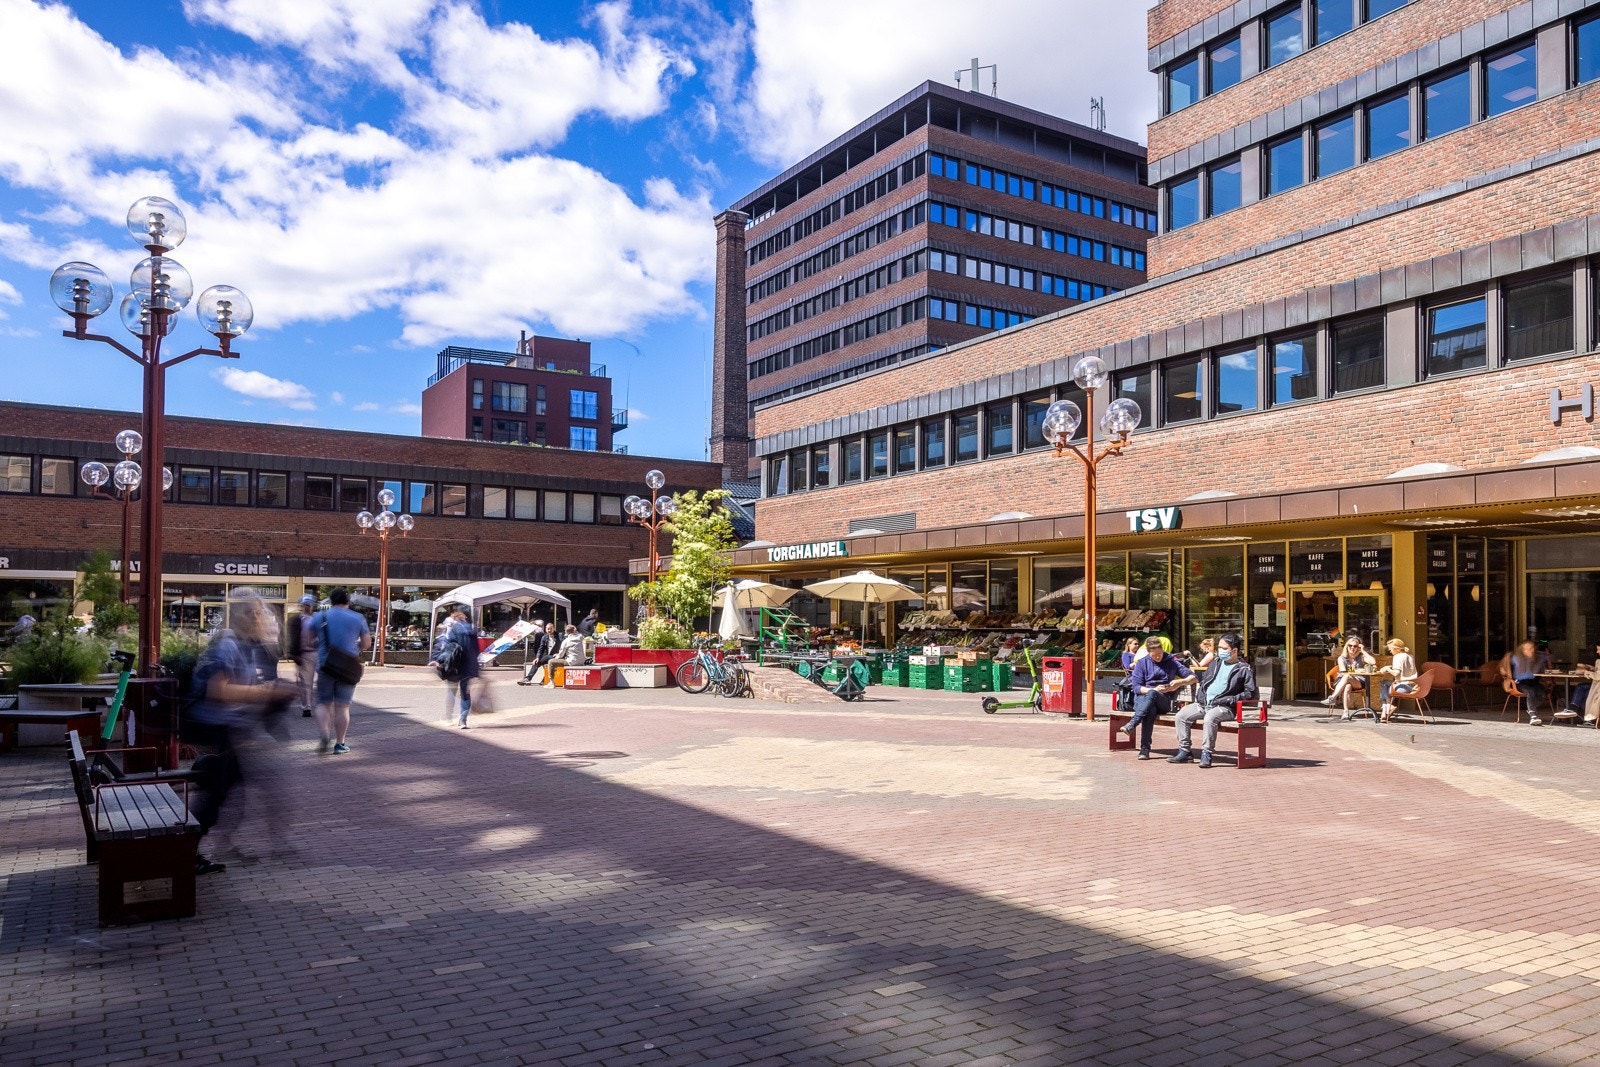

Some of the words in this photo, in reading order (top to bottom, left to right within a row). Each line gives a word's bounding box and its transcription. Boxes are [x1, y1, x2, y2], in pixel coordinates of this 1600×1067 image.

[1549, 382, 1600, 422] H
[1126, 506, 1177, 532] TSV
[767, 541, 845, 562] TORGHANDEL
[1308, 553, 1324, 561] KAFFE
[1361, 550, 1378, 558] MØTE
[214, 562, 269, 575] SCENE
[1310, 563, 1322, 571] BAR
